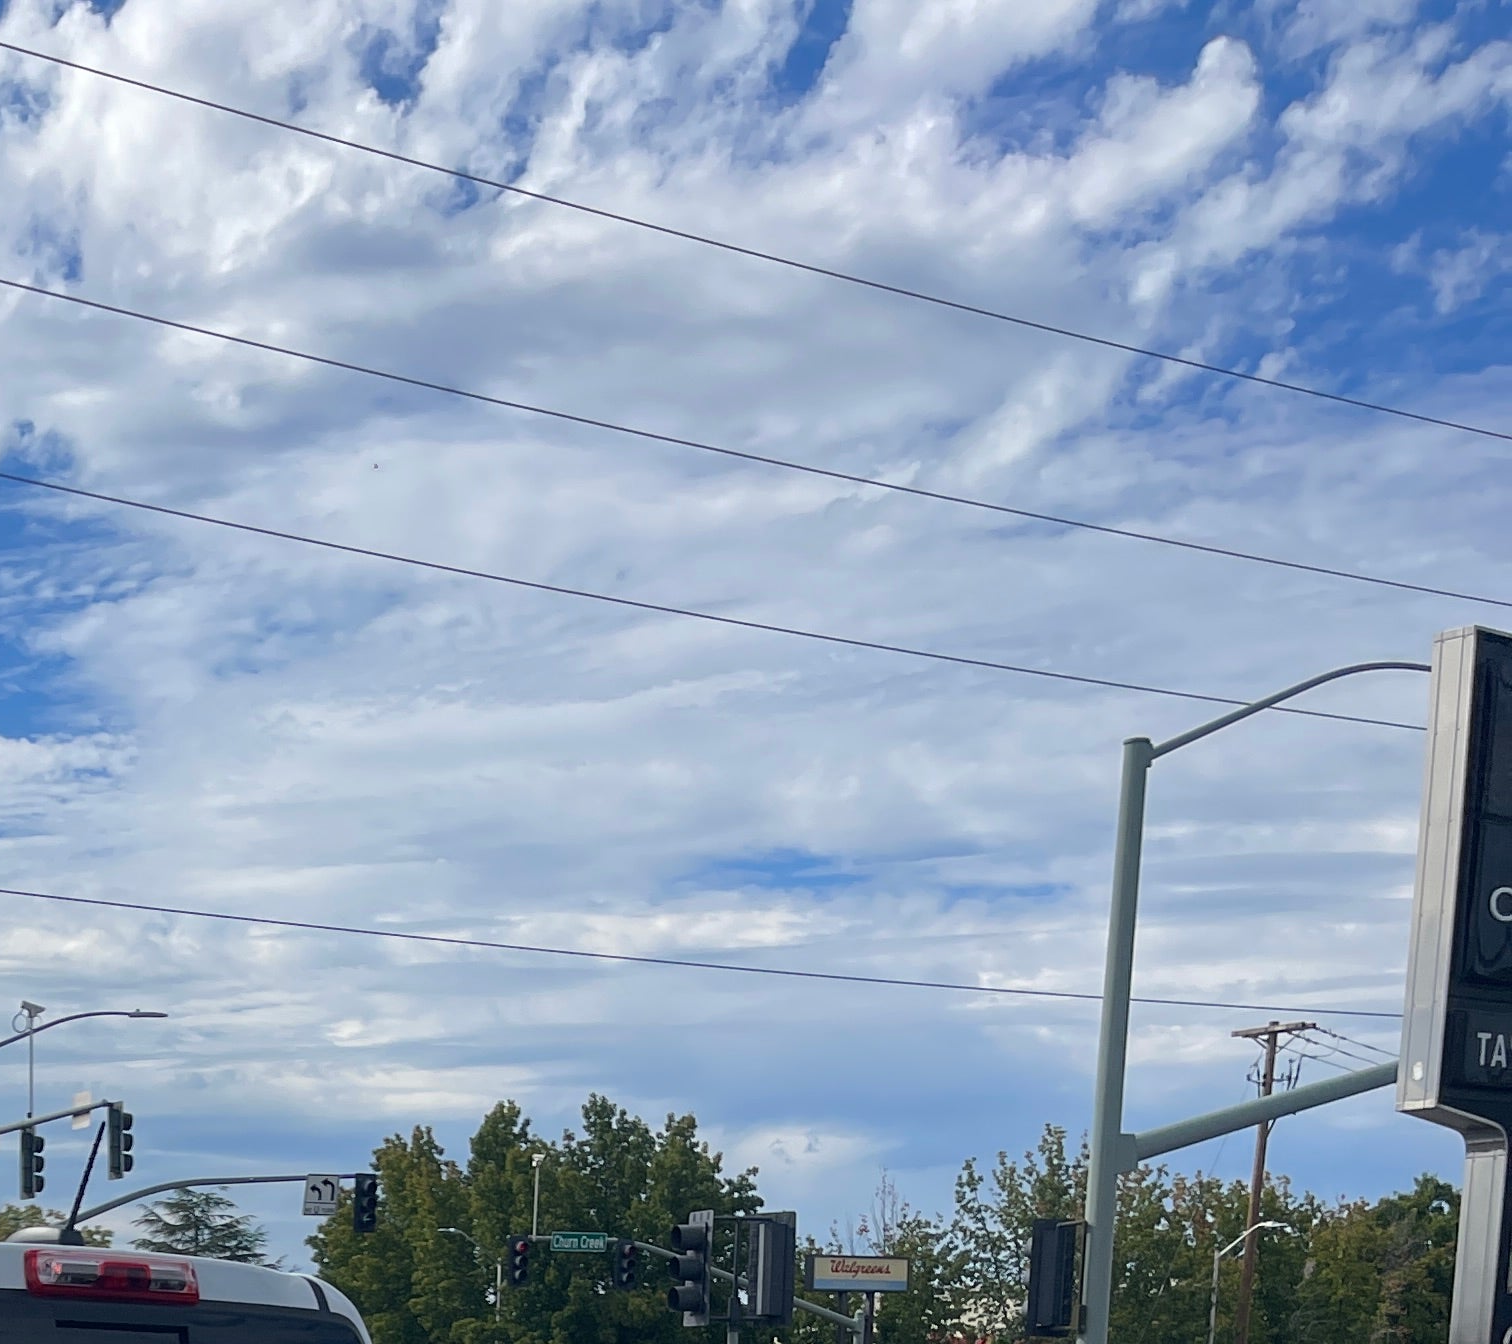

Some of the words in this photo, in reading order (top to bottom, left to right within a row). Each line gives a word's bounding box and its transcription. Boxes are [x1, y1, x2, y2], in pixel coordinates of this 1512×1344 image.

[553, 1235, 578, 1248] Churn
[580, 1236, 604, 1249] Creek
[830, 1259, 891, 1278] Walgreens
